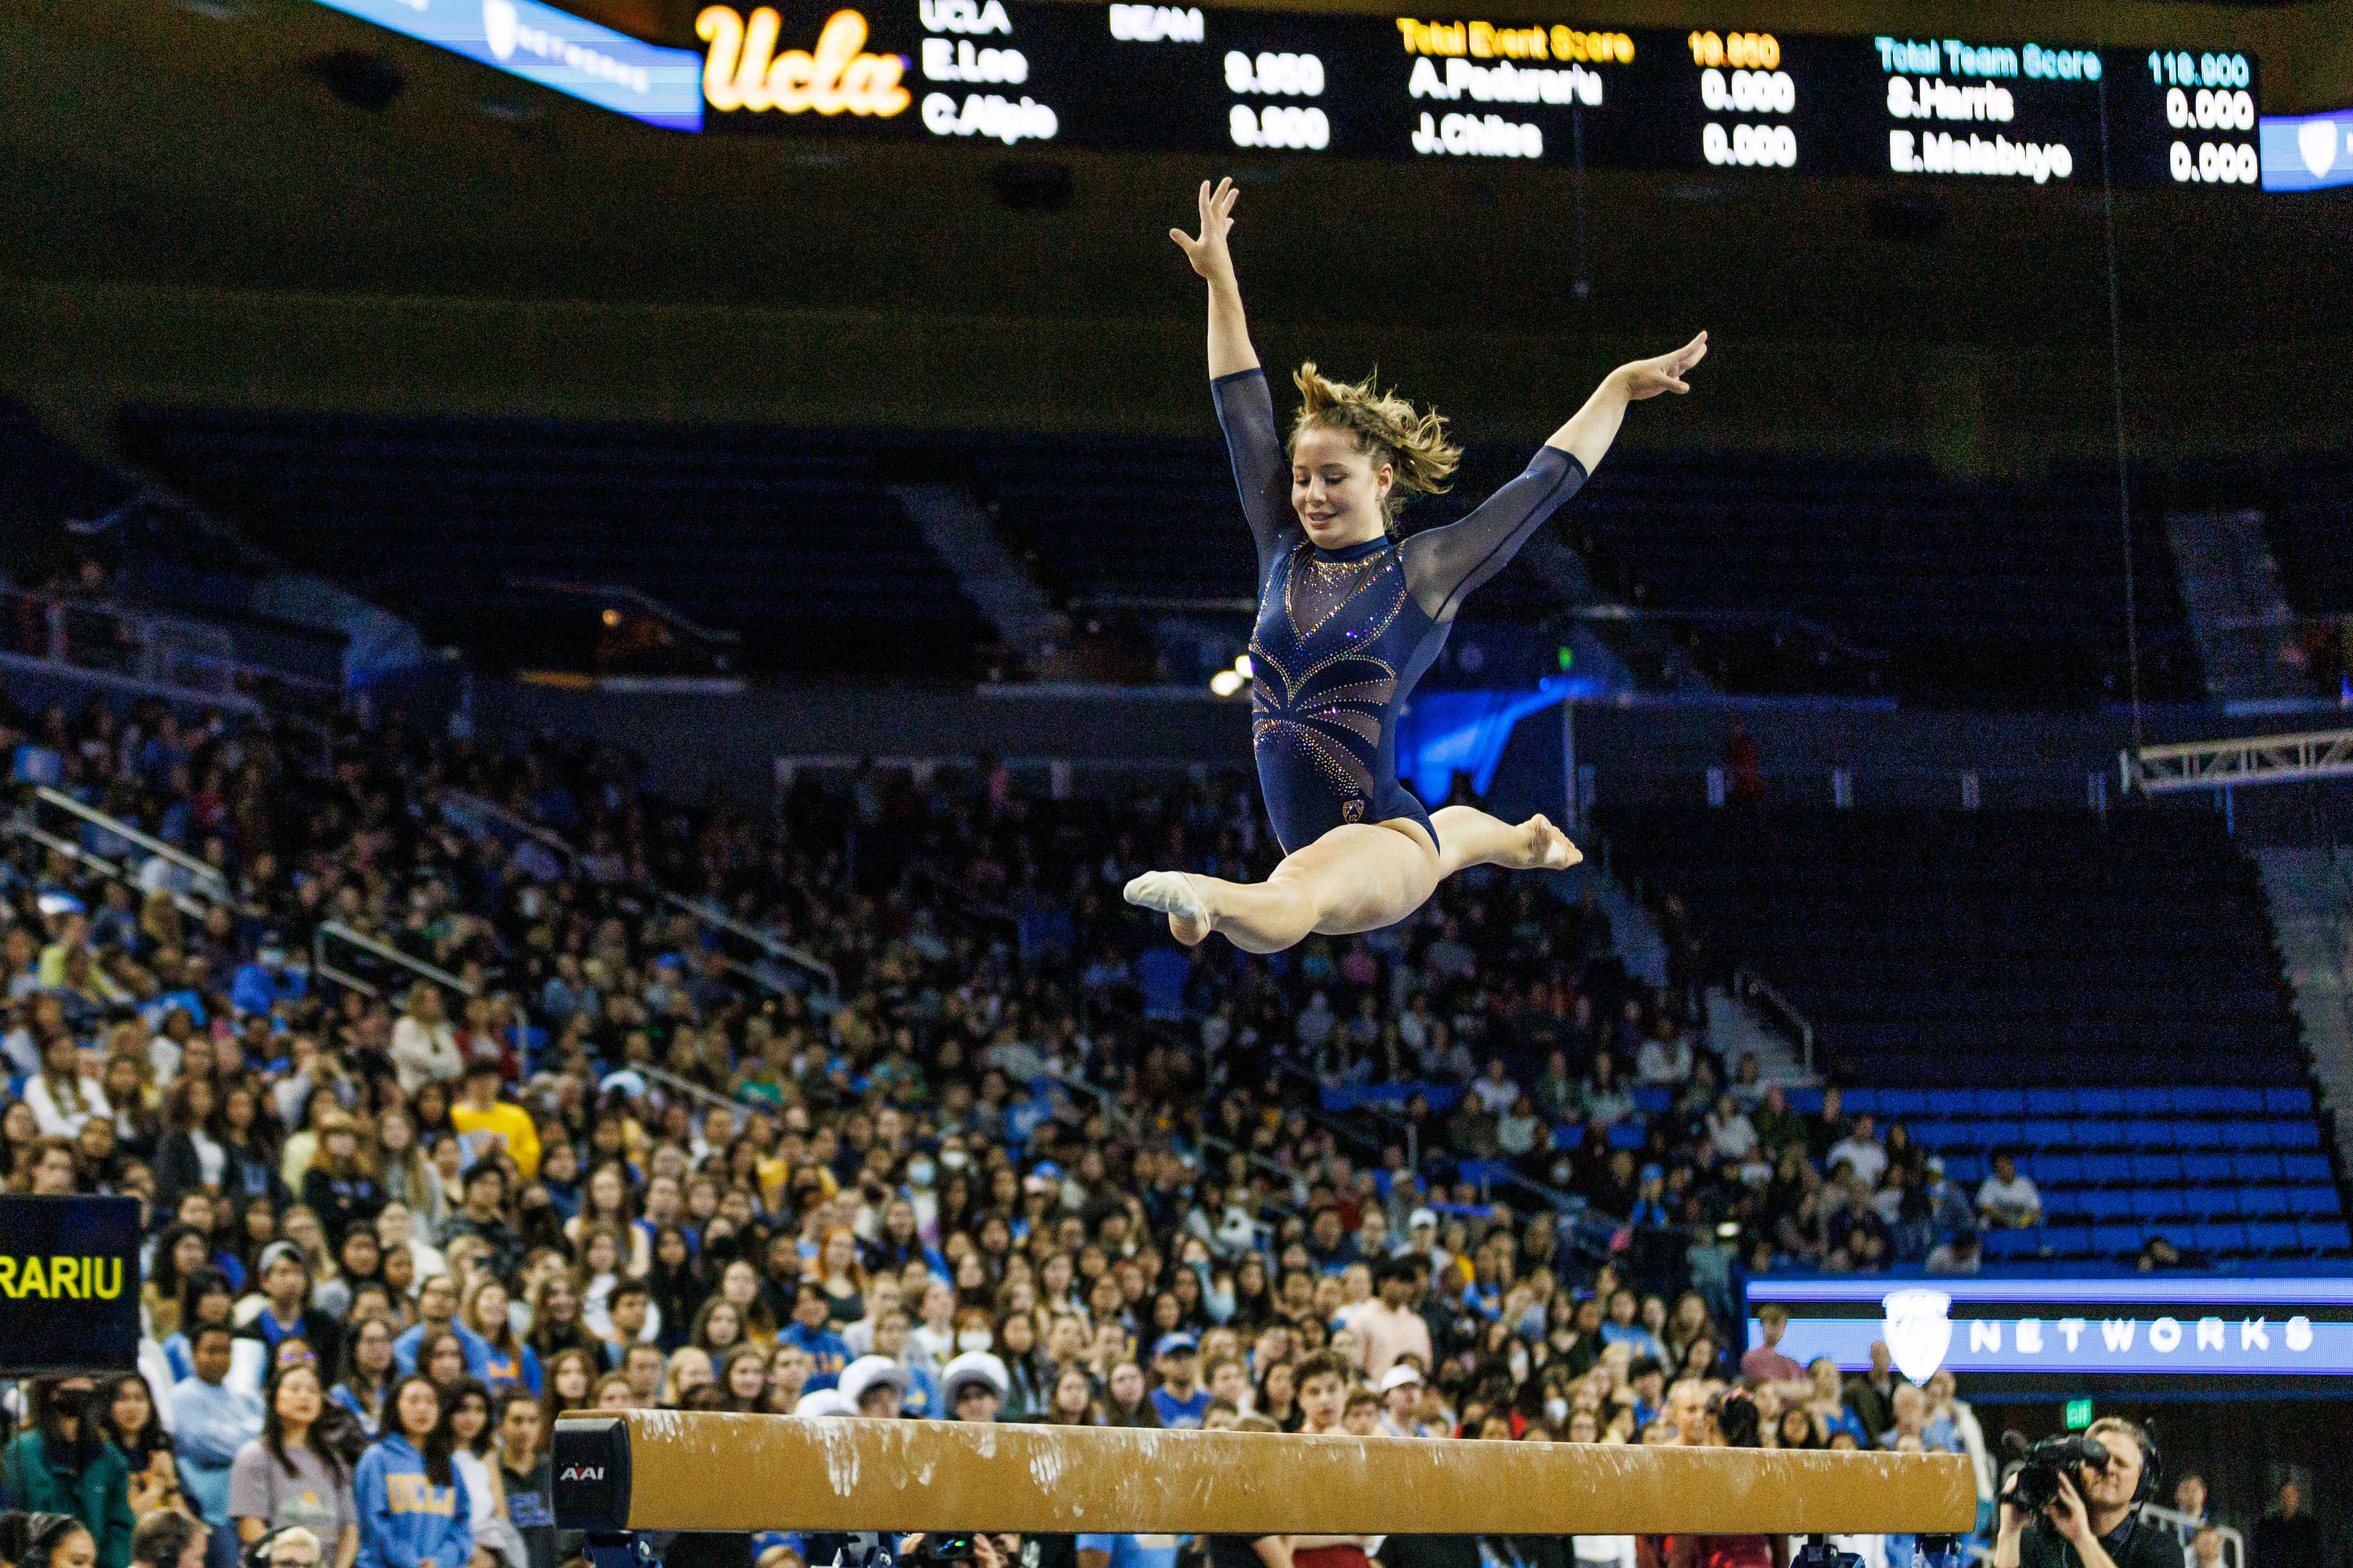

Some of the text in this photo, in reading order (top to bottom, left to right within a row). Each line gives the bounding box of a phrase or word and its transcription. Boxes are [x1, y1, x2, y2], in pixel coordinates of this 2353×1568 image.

[920, 0, 1012, 34] UCLA
[1396, 18, 1467, 57] Total
[1550, 25, 1635, 64] Score
[1875, 37, 2101, 81] Total Team Score
[1702, 69, 1795, 113] 0.000
[2167, 88, 2254, 130] 0.000
[1703, 123, 1796, 167] 0.000
[2170, 142, 2257, 183] 0.000
[0, 1256, 122, 1299] RARIU
[1971, 1317, 2313, 1352] NETWORKS
